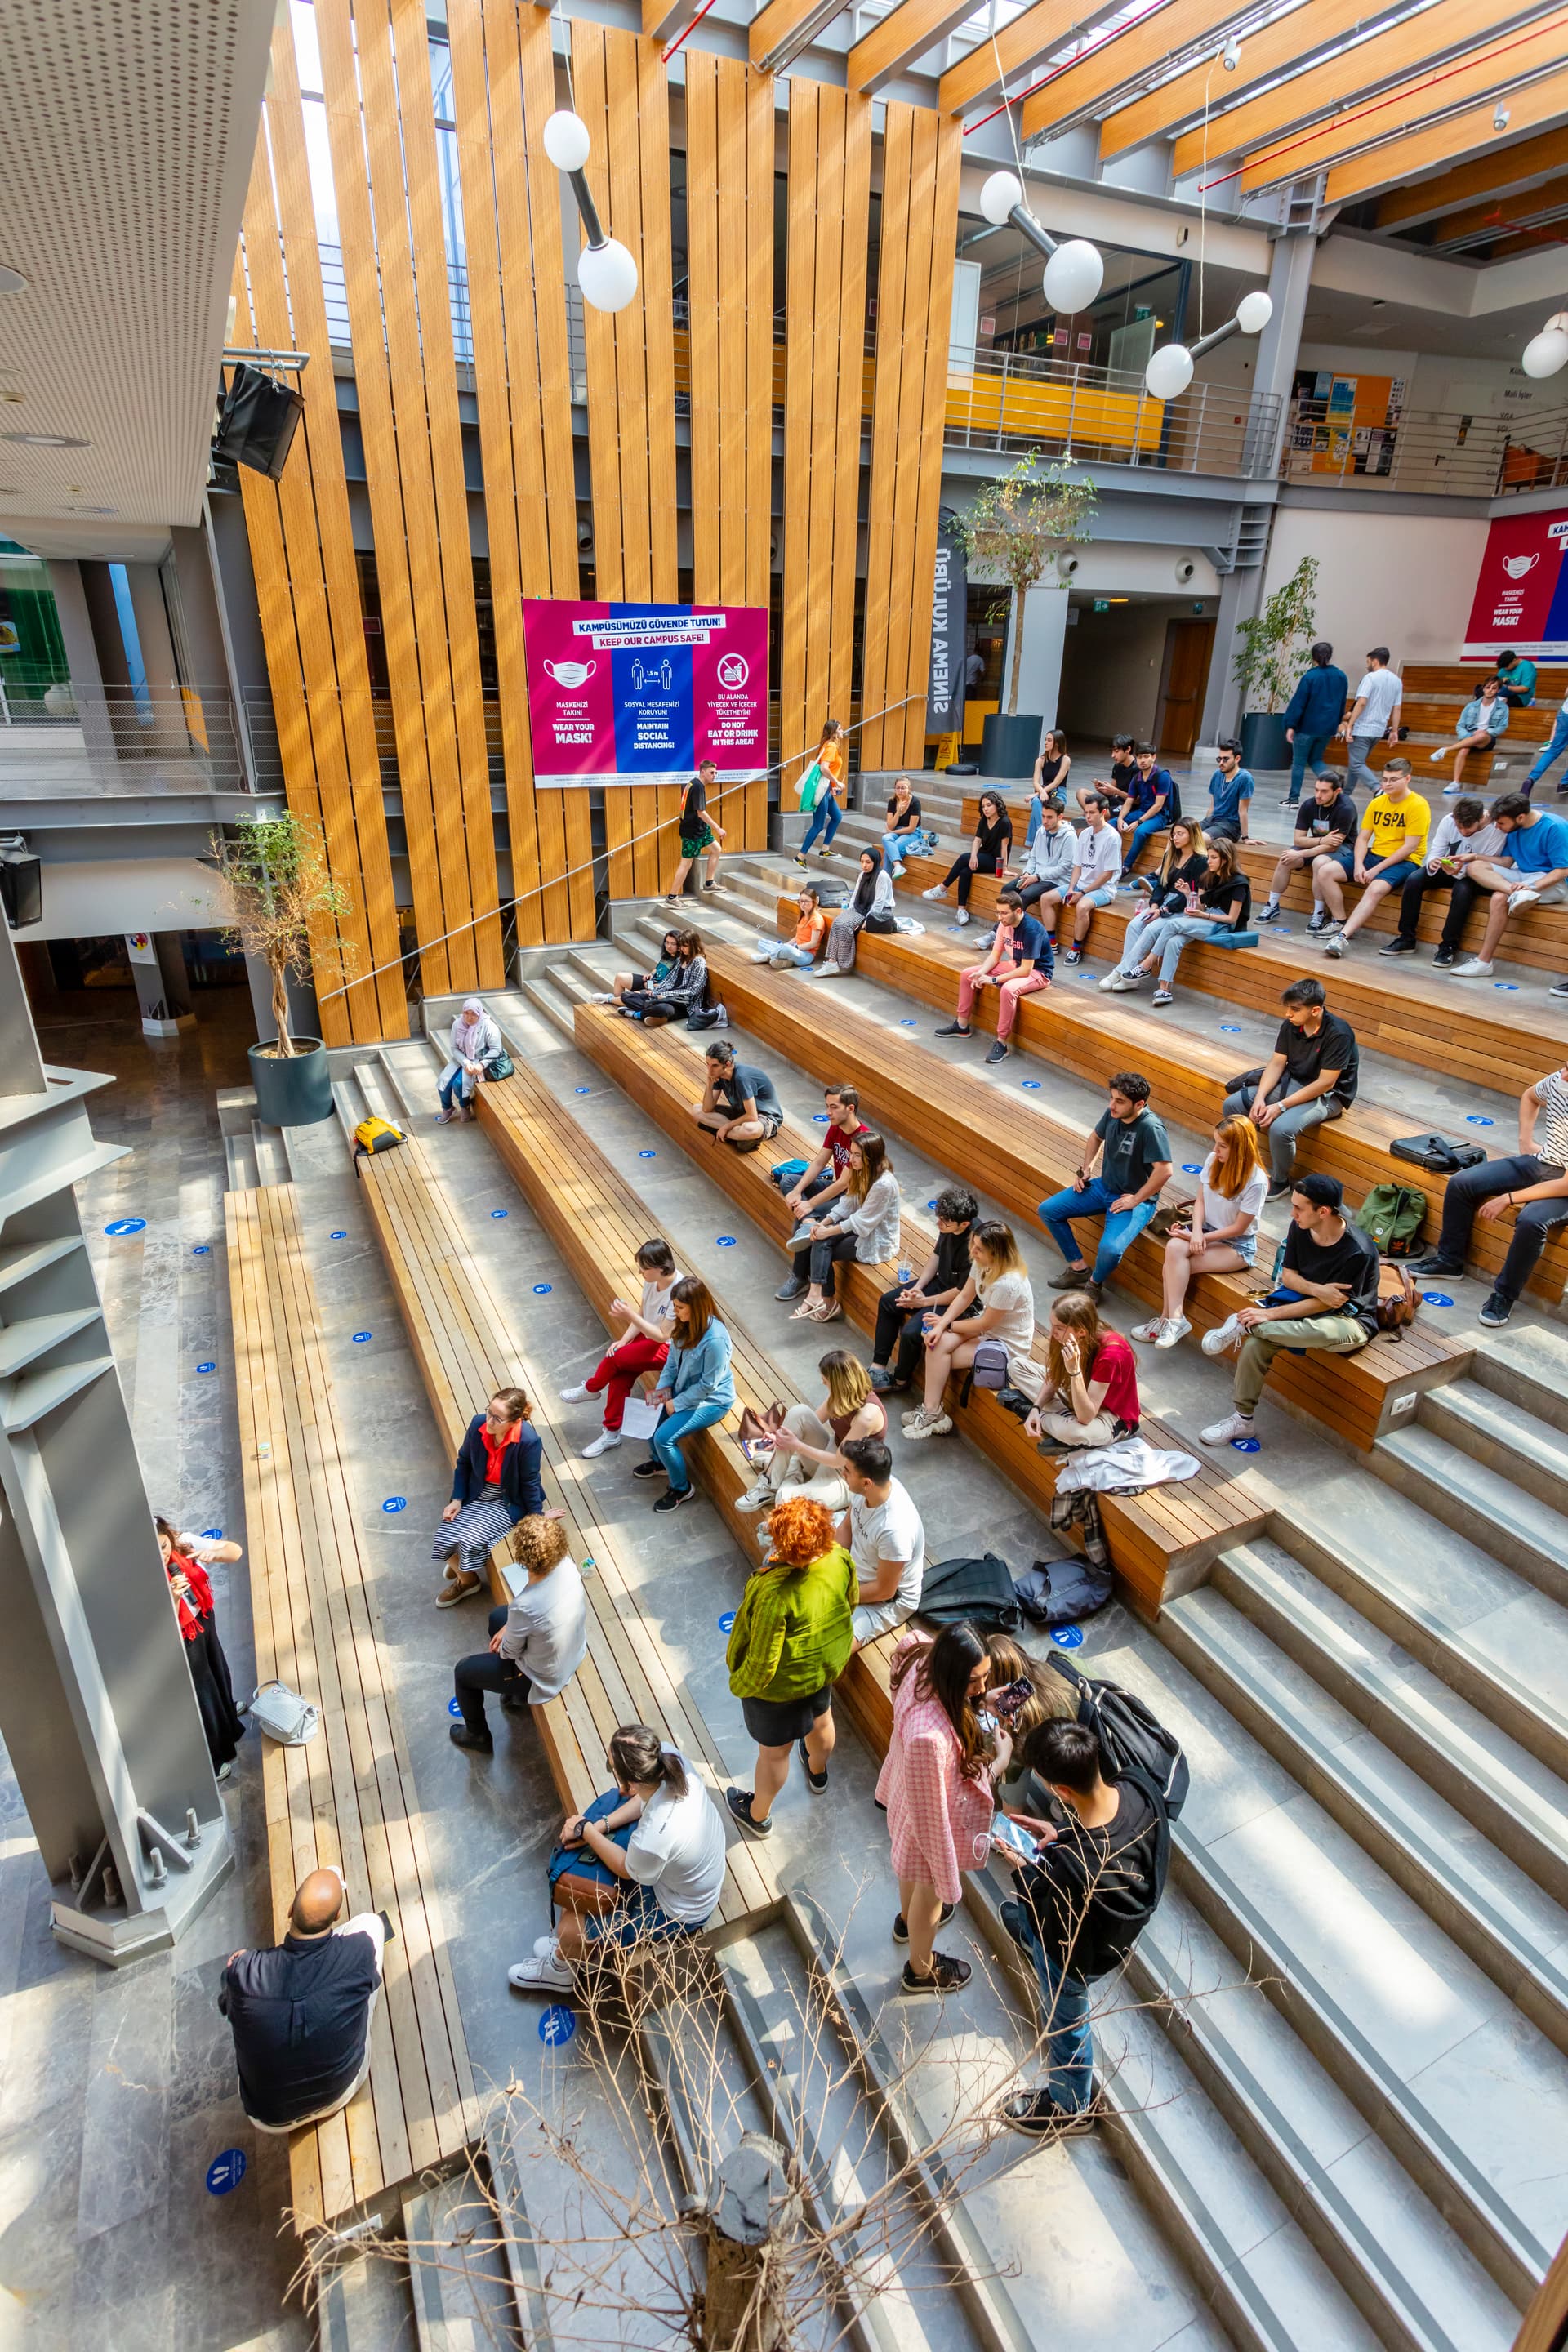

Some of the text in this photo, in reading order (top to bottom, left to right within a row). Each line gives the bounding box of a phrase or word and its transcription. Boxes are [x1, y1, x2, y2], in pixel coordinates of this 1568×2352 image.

[579, 618, 720, 632] KAMPÜSÜMÜZÜ GÜVENDE TUTUN!
[1492, 616, 1520, 626] MASK!
[599, 634, 704, 647] KEEP OUR CAMPUS SAFE!
[637, 732, 669, 740] SOCIAL
[735, 729, 759, 737] DRINK
[555, 733, 593, 744] MASK!
